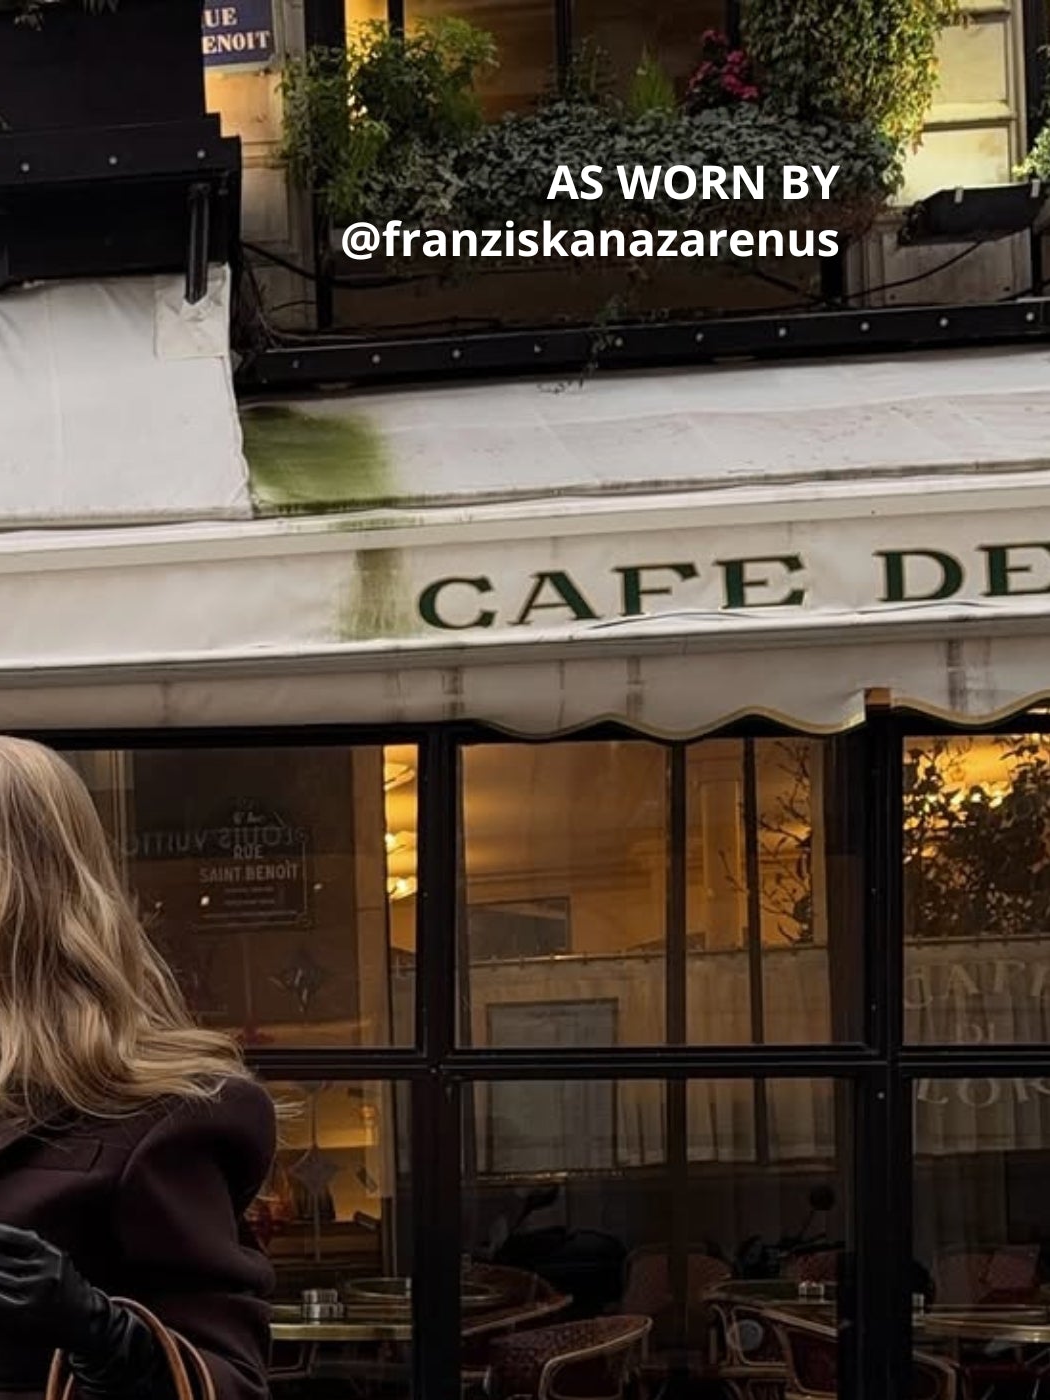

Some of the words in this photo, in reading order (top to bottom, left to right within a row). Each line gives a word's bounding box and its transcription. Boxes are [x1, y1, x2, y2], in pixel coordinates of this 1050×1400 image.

[204, 7, 237, 27] UE
[202, 30, 270, 54] ENOIT
[418, 553, 807, 630] CAFE
[873, 541, 1050, 603] DE
[199, 866, 242, 882] SAINT
